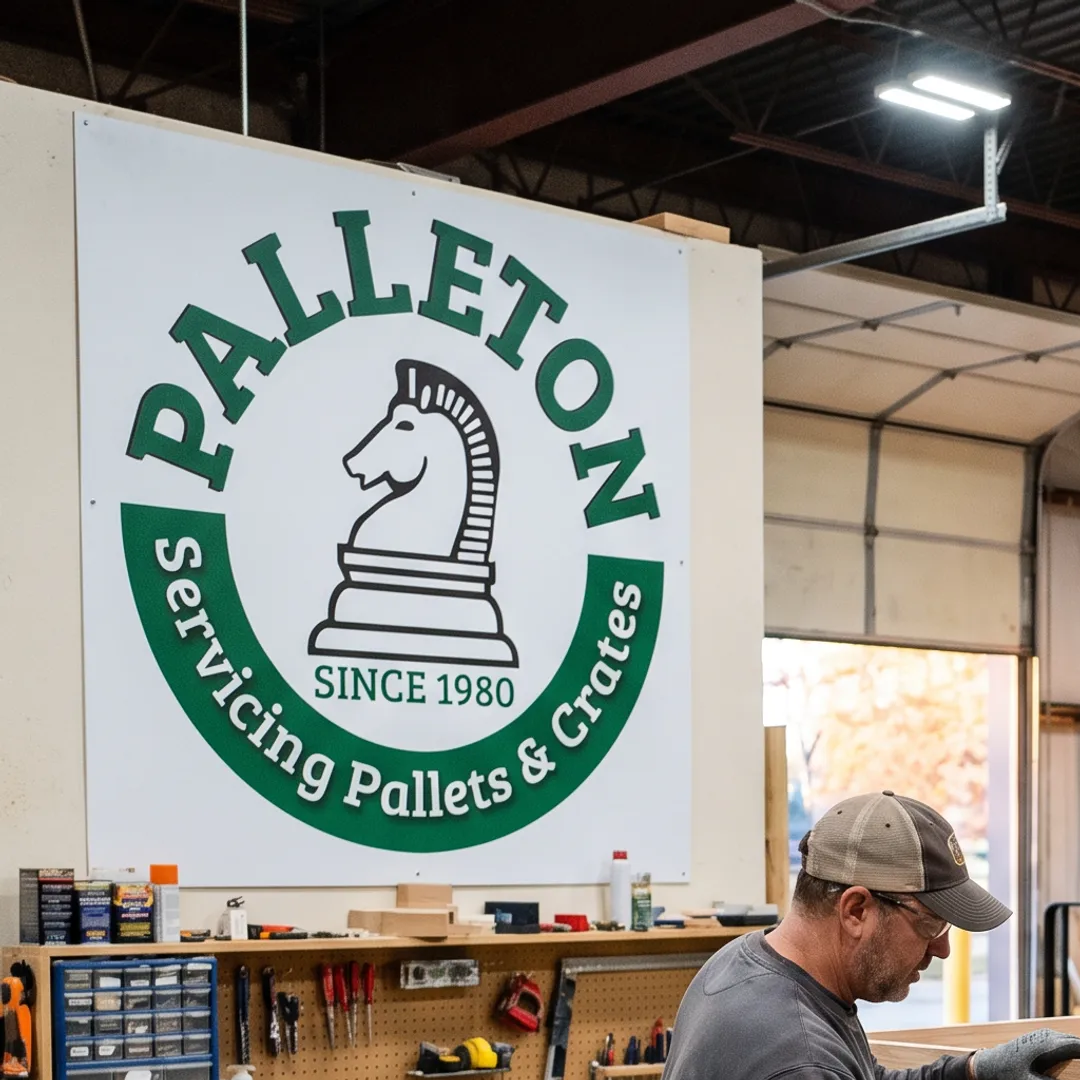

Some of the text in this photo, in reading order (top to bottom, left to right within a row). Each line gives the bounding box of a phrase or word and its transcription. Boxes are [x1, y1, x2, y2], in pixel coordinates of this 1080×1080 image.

[125, 209, 661, 529] PALLETON
[154, 536, 642, 818] Servicing Pallets & Crates
[314, 664, 515, 708] SINCE 1980
